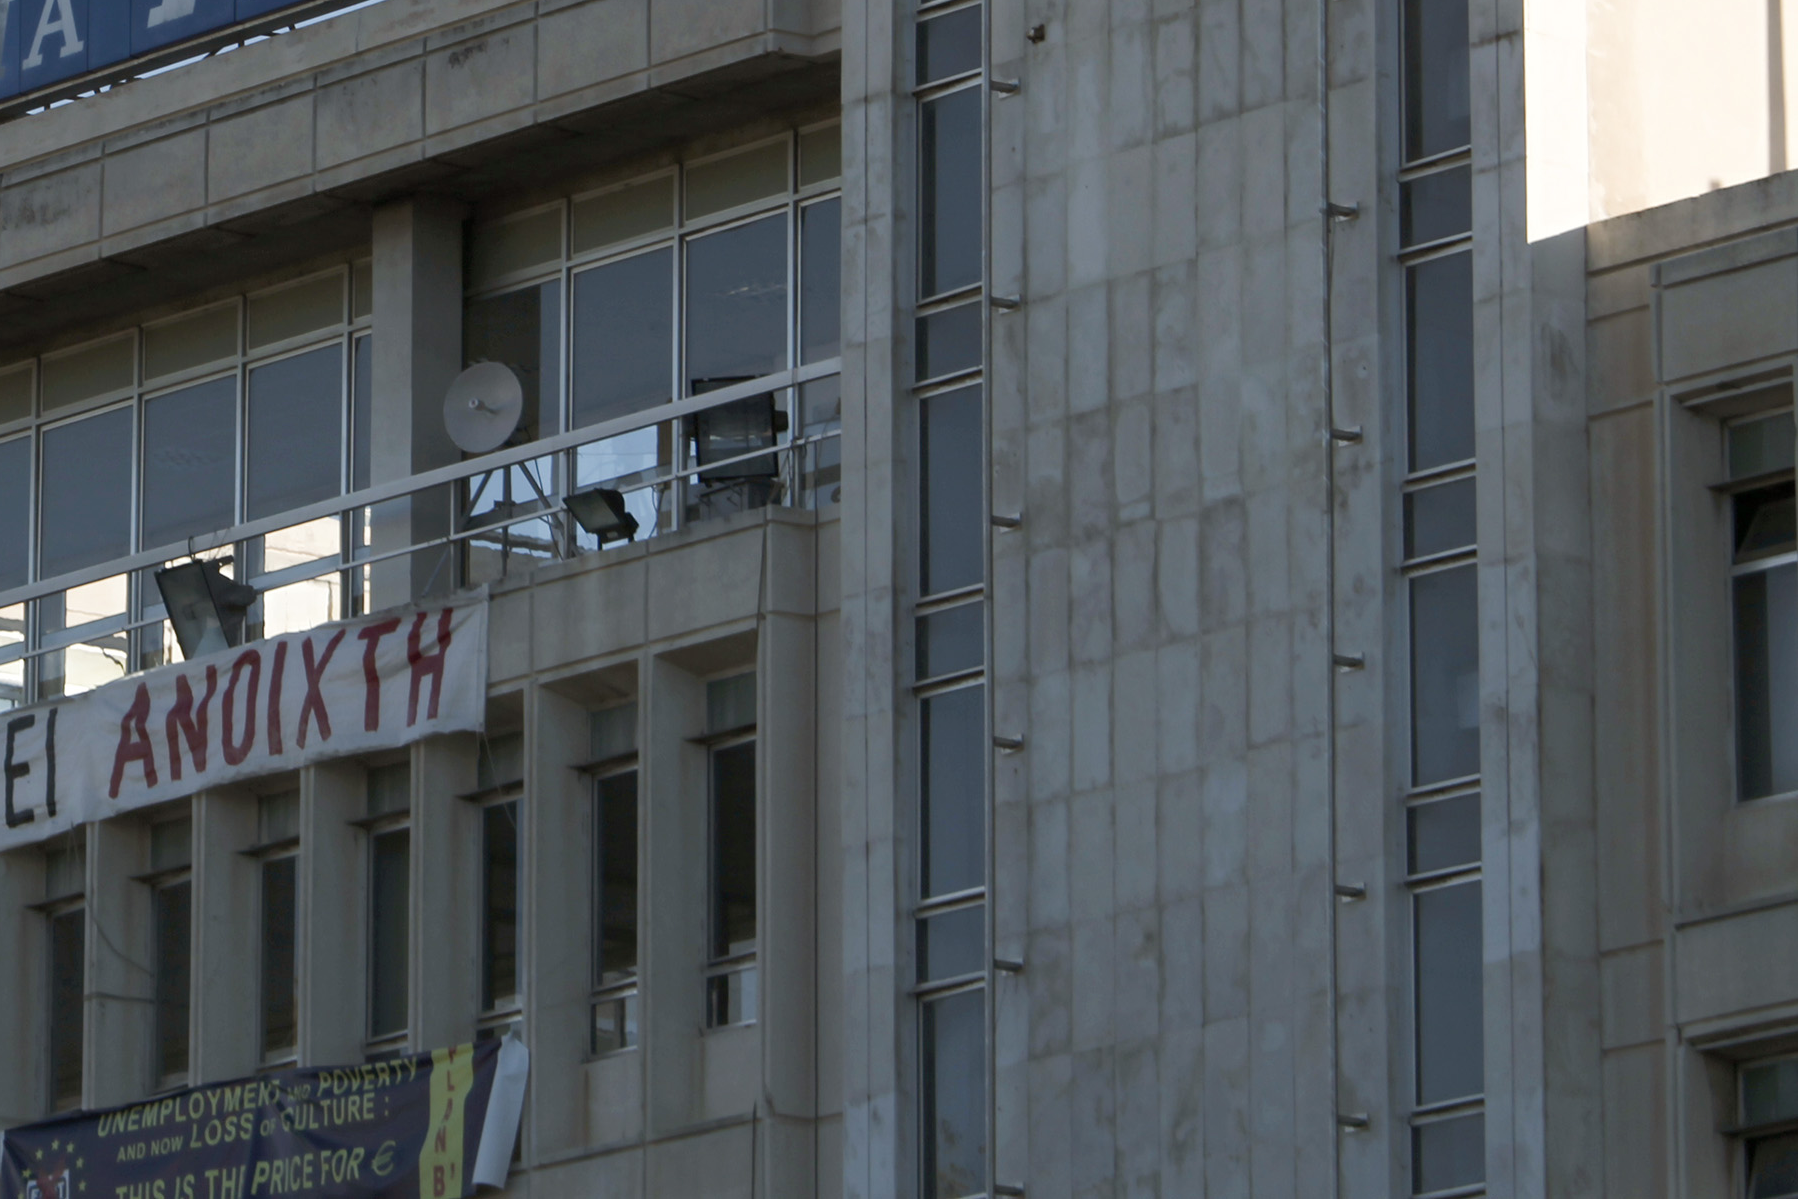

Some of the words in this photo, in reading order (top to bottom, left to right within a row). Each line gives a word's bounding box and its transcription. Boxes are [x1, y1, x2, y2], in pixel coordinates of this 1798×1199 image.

[108, 608, 454, 799] ΑΝΟΙΧΤΗ
[97, 1079, 280, 1137] UNEMPLOYMENT
[317, 1056, 418, 1097] POVERTY
[117, 1142, 146, 1163] AND
[151, 1136, 184, 1156] NOW
[190, 1113, 254, 1148] LOSS
[260, 1118, 276, 1137] OF
[175, 1174, 195, 1199] IS
[251, 1153, 314, 1196] PRICE
[321, 1147, 365, 1185] FOR
[371, 1140, 396, 1176] €
